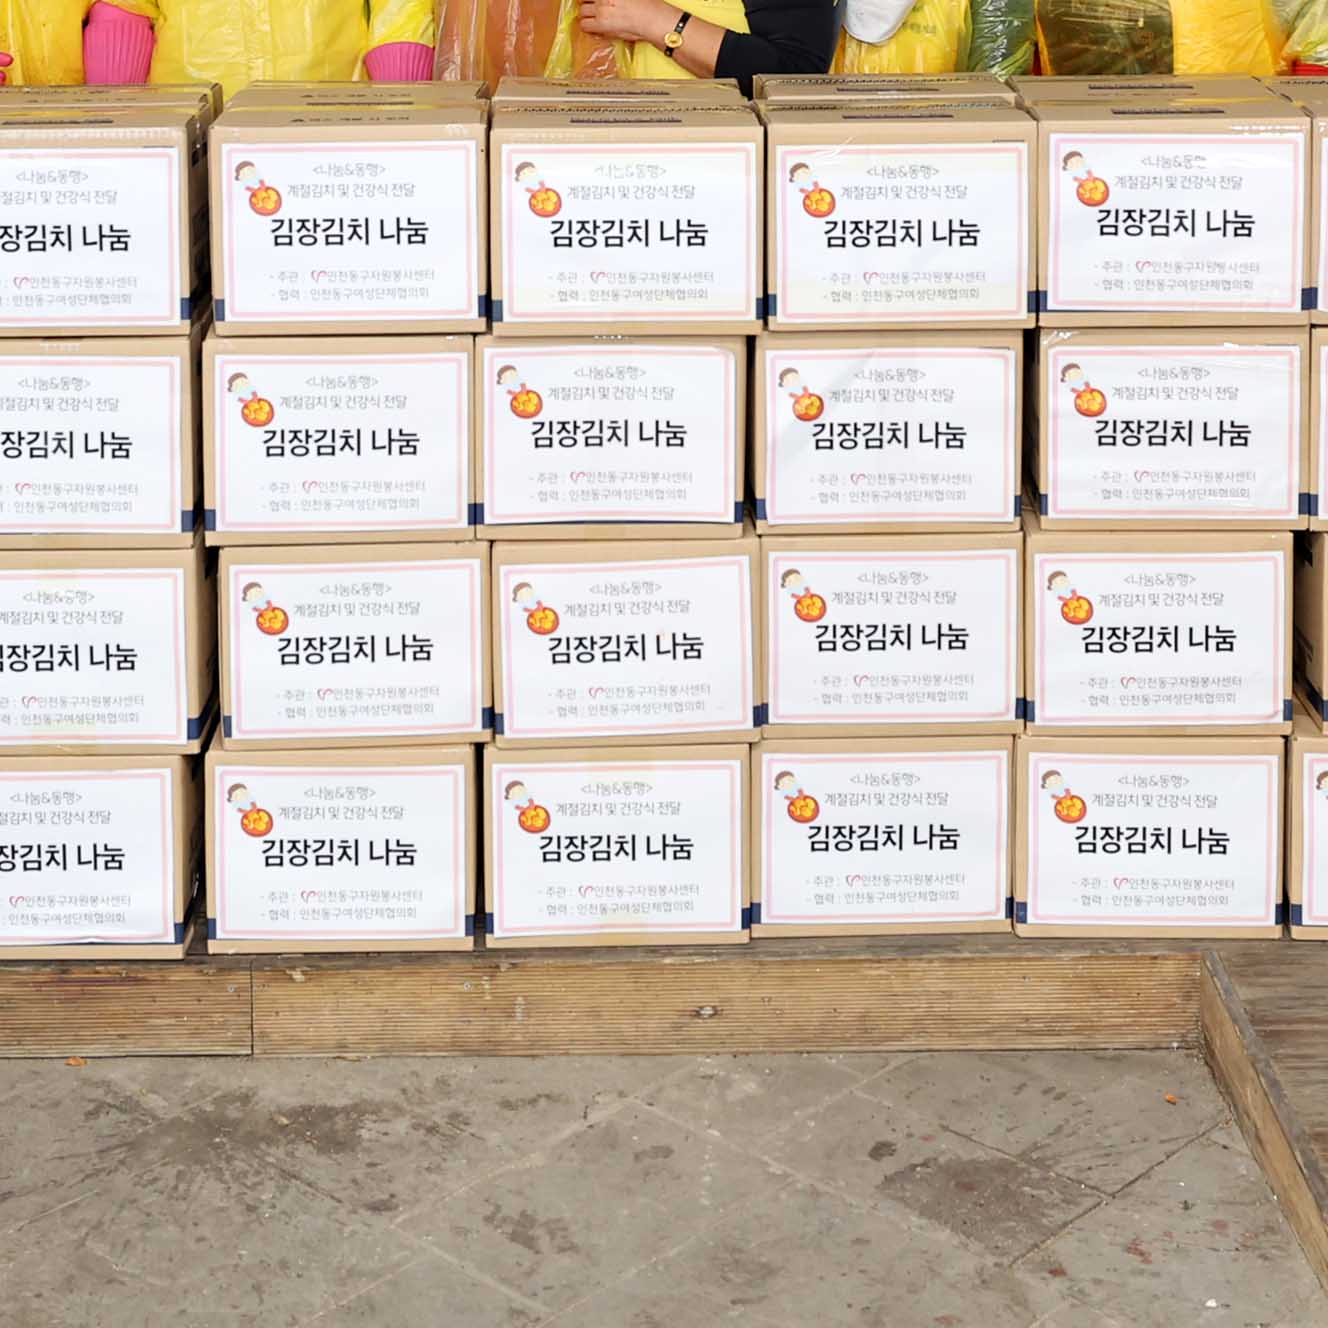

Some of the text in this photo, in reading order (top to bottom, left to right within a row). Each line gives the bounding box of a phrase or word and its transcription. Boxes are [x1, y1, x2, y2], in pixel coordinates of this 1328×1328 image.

[271, 217, 429, 247] 김장김치 나눔
[550, 218, 709, 248] 김장김치 나눔
[824, 219, 980, 248] 김장김치 나눔
[263, 428, 420, 457] 김장김치 나눔
[531, 419, 687, 449] 김장김치 나눔
[1095, 419, 1252, 447] 김장김치 나눔
[278, 634, 433, 666] 김장김치 나눔
[549, 632, 704, 665] 김장김치 나눔
[1081, 624, 1237, 654] 김장김치 나눔
[539, 833, 694, 863] 김장김치 나눔
[808, 823, 961, 852] 김장김치 나눔
[77, 843, 125, 871] 나눔
